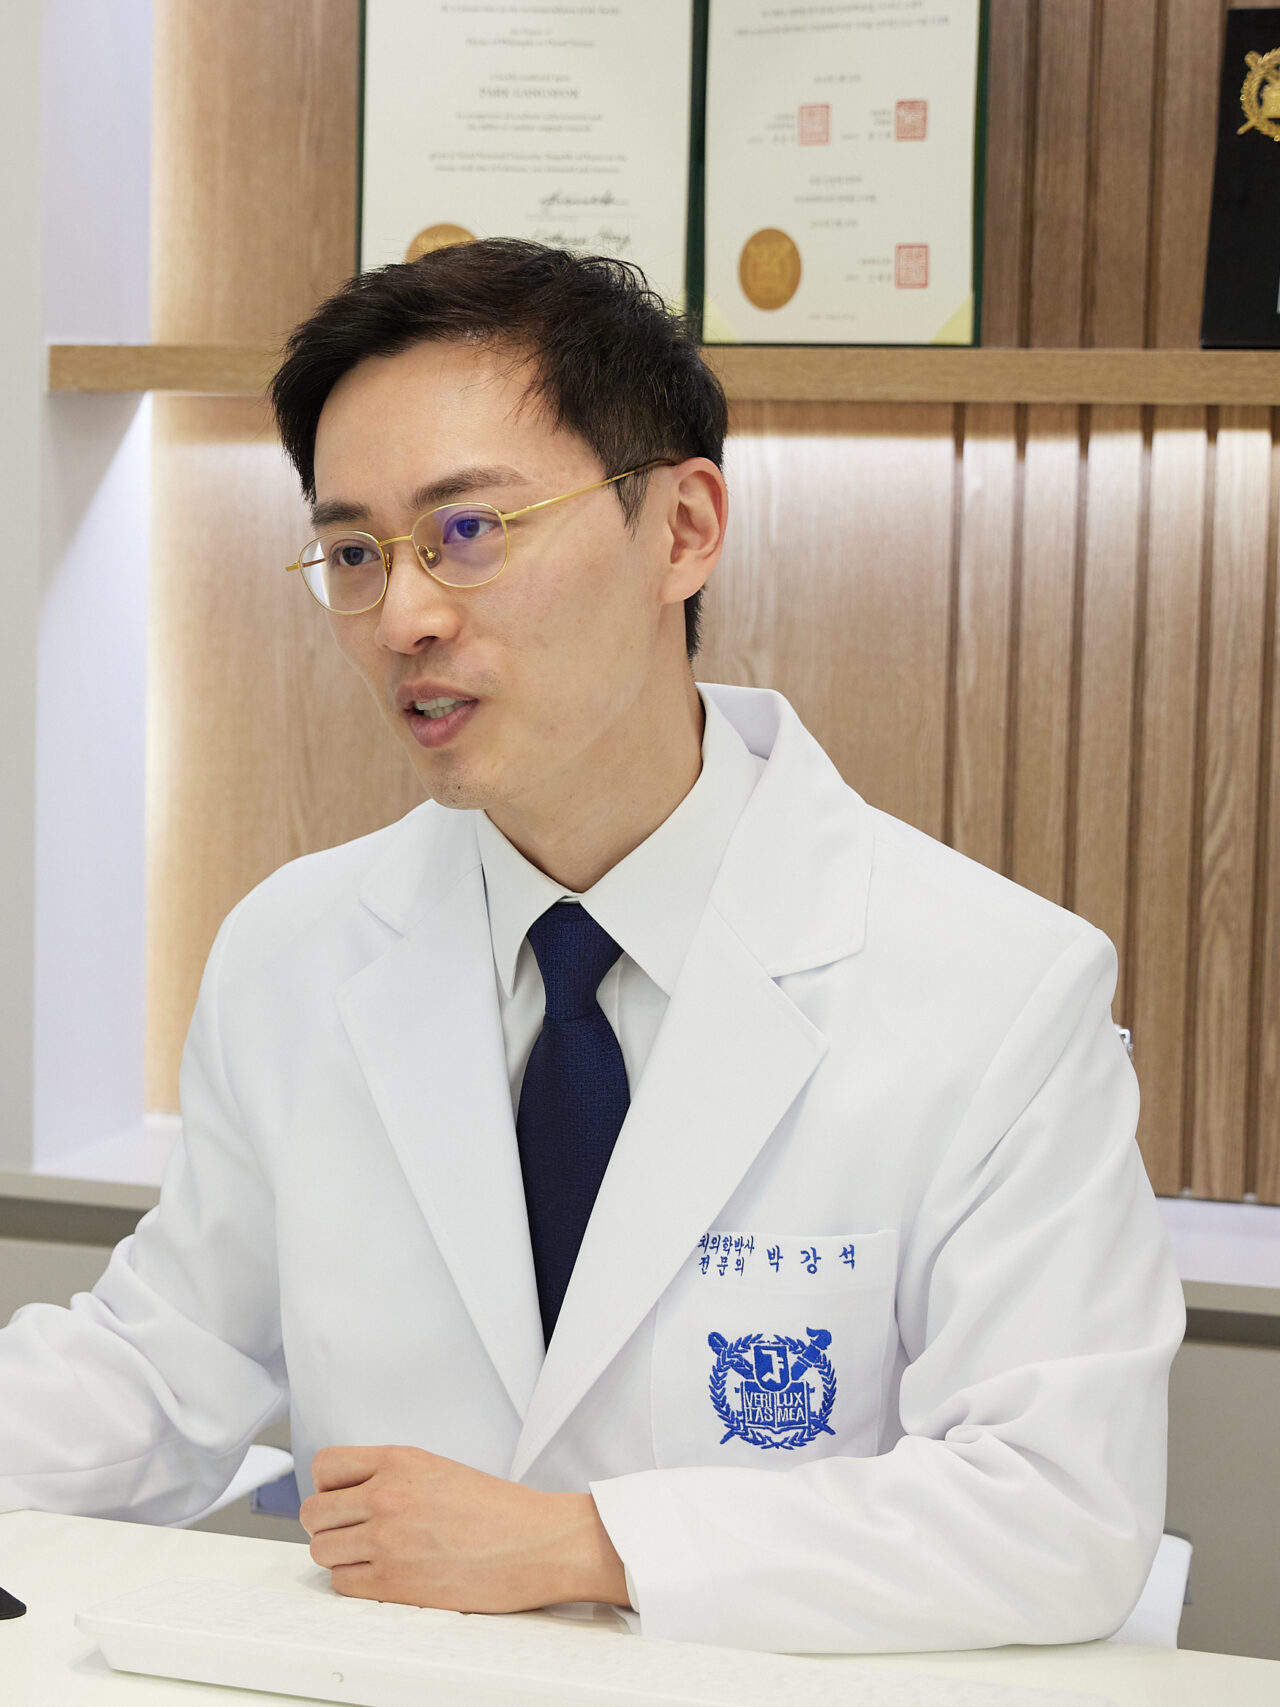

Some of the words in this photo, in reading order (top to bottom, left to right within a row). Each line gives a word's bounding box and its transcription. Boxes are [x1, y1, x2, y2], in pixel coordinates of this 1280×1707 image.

[777, 1391, 803, 1407] LUX
[745, 1407, 773, 1422] TAS
[777, 1407, 805, 1422] MEA
